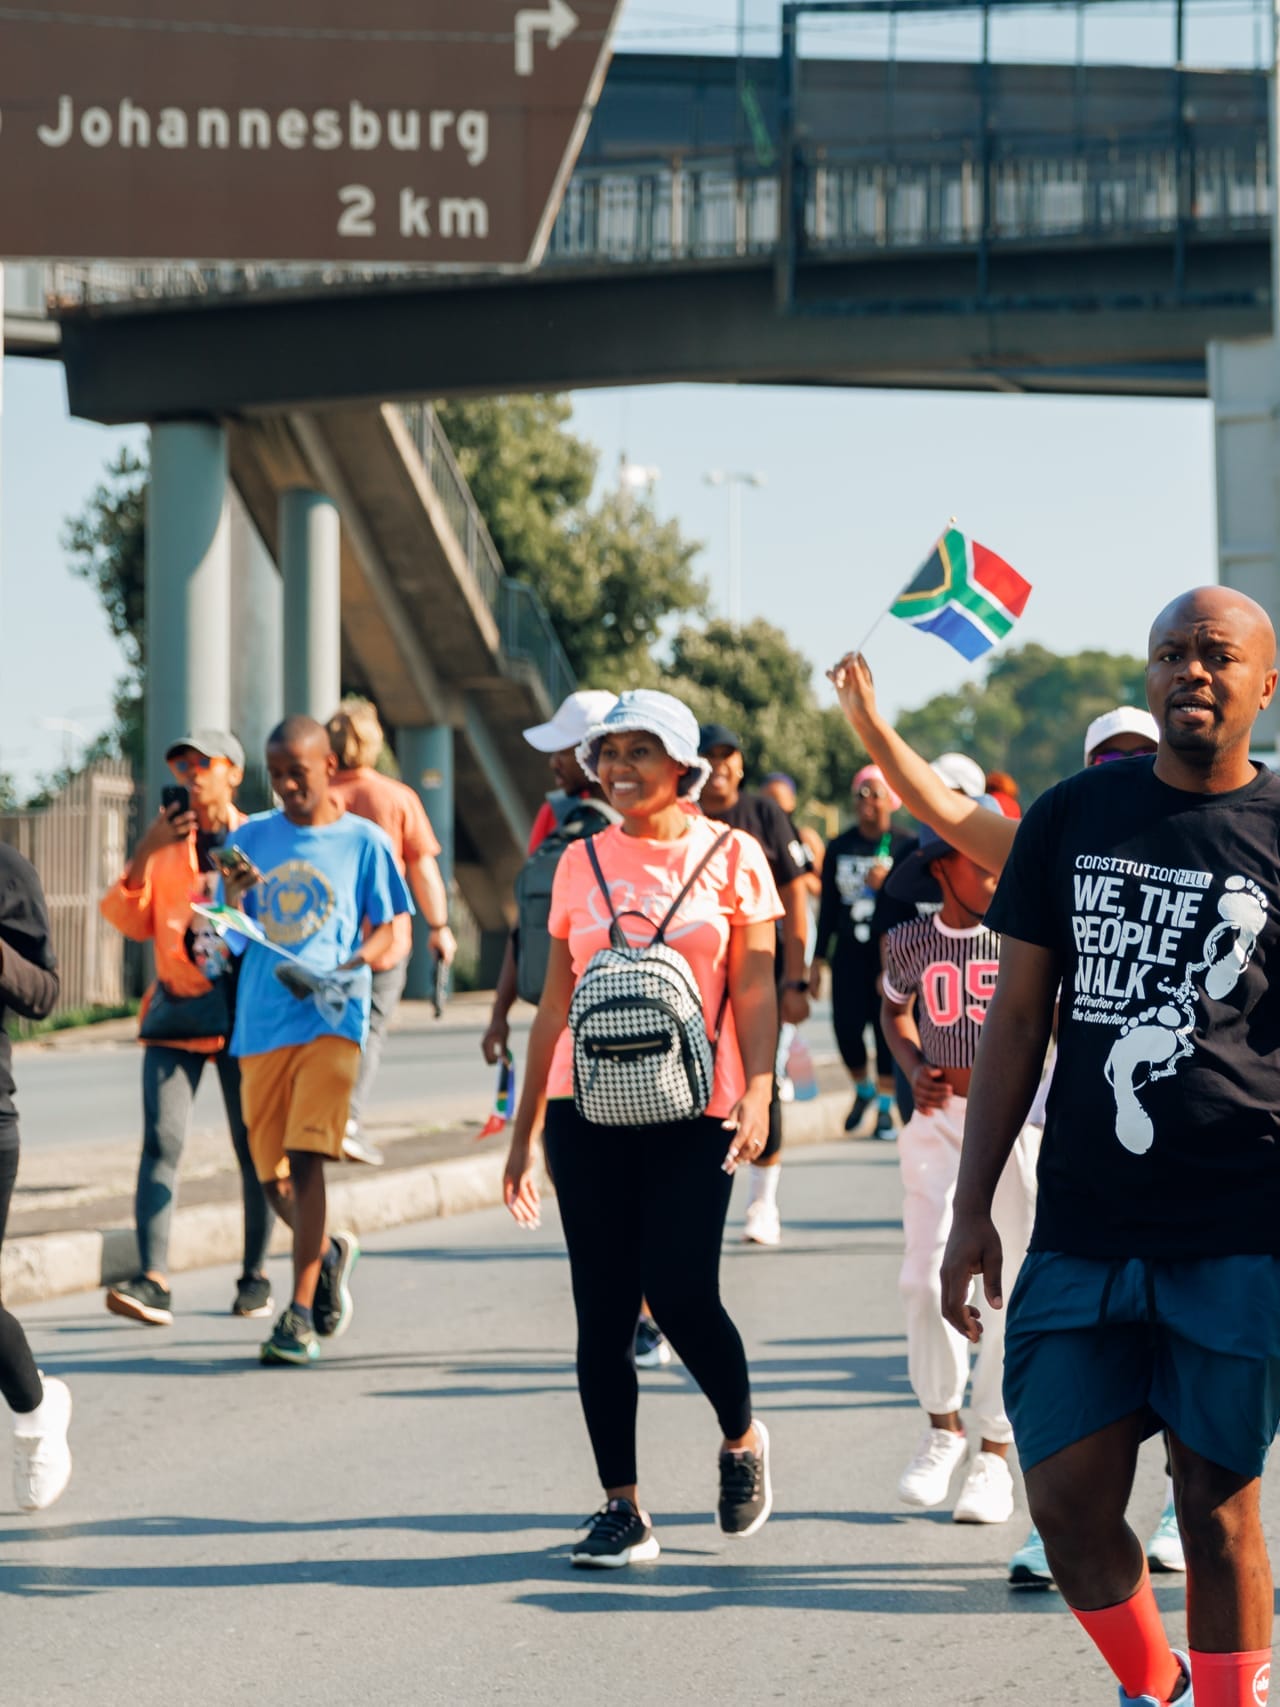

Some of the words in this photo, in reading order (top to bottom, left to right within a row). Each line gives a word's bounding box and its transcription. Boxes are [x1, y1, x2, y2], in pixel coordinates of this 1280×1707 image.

[38, 94, 489, 167] Johannesburg
[337, 185, 376, 238] 2
[399, 187, 489, 239] km
[1073, 874, 1126, 920] WE,
[1140, 884, 1203, 928] THE
[1072, 915, 1182, 966] PEOPLE
[921, 960, 1000, 1027] 05
[1074, 955, 1153, 1000] WALK
[1114, 999, 1130, 1010] of
